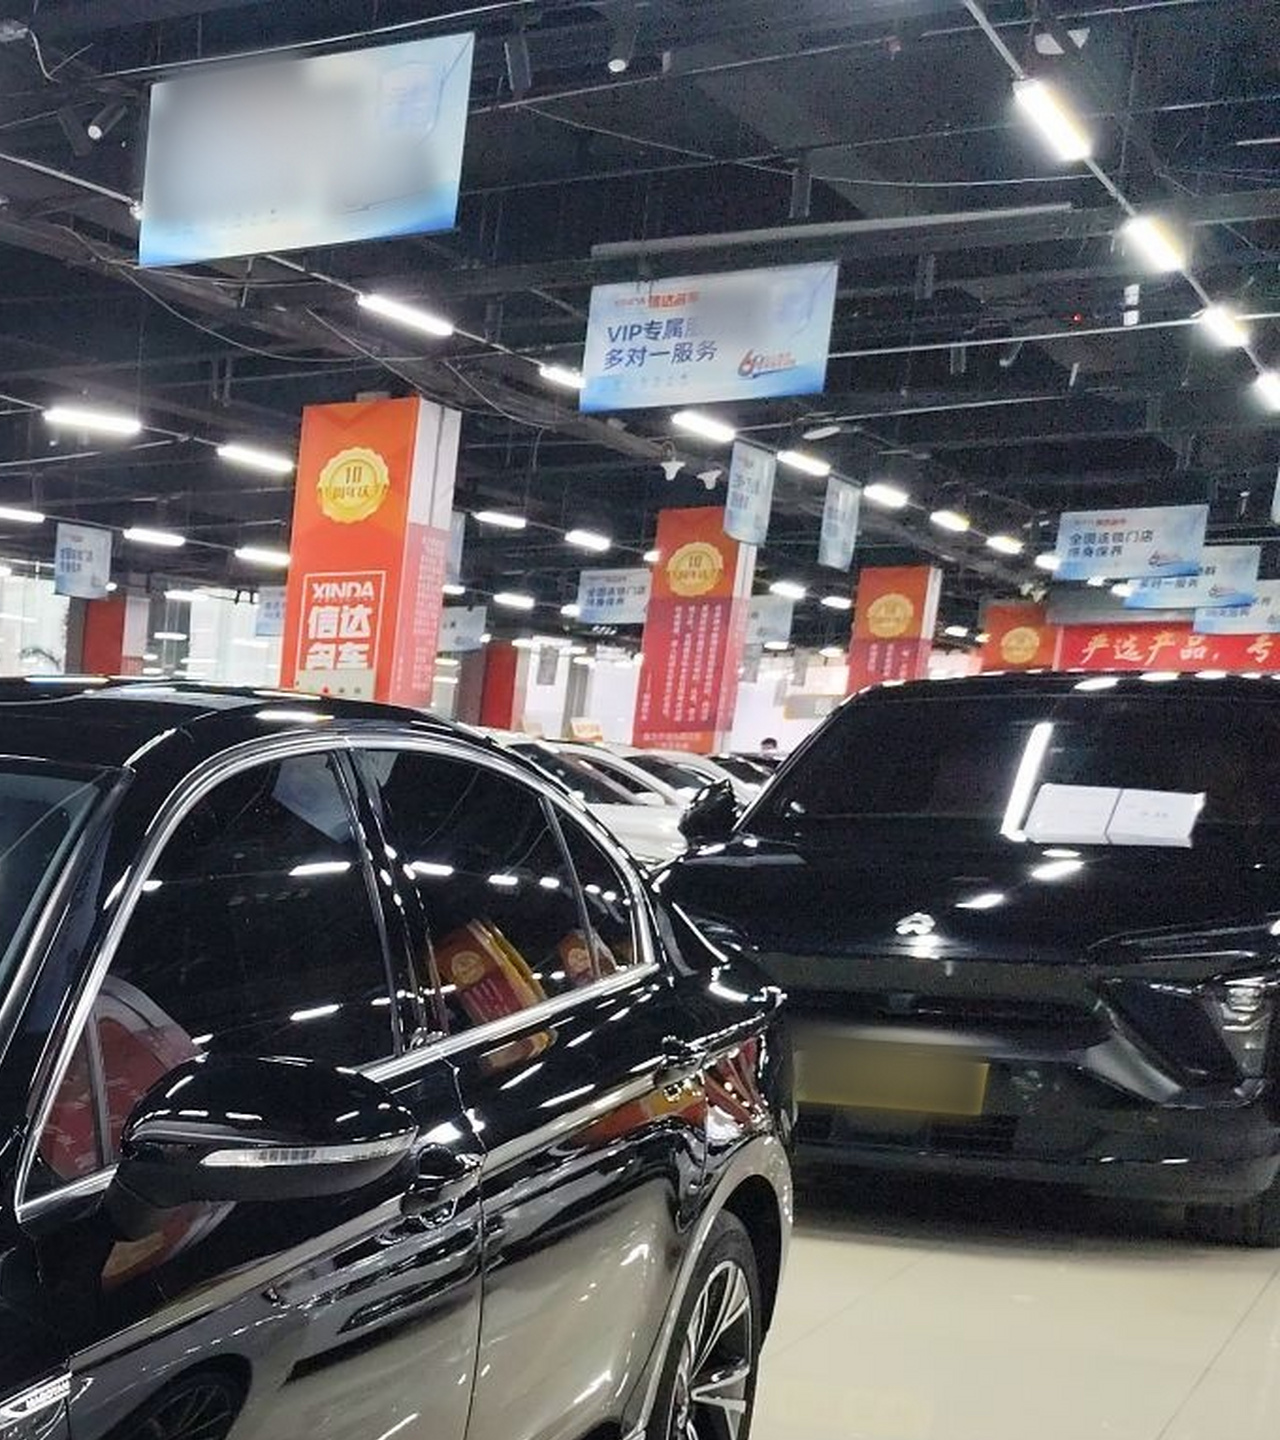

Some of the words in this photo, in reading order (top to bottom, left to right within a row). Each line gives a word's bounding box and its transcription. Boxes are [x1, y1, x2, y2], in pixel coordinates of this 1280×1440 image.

[604, 340, 718, 370] 多对一服务
[311, 581, 375, 599] XINDA
[307, 604, 373, 639] 信达
